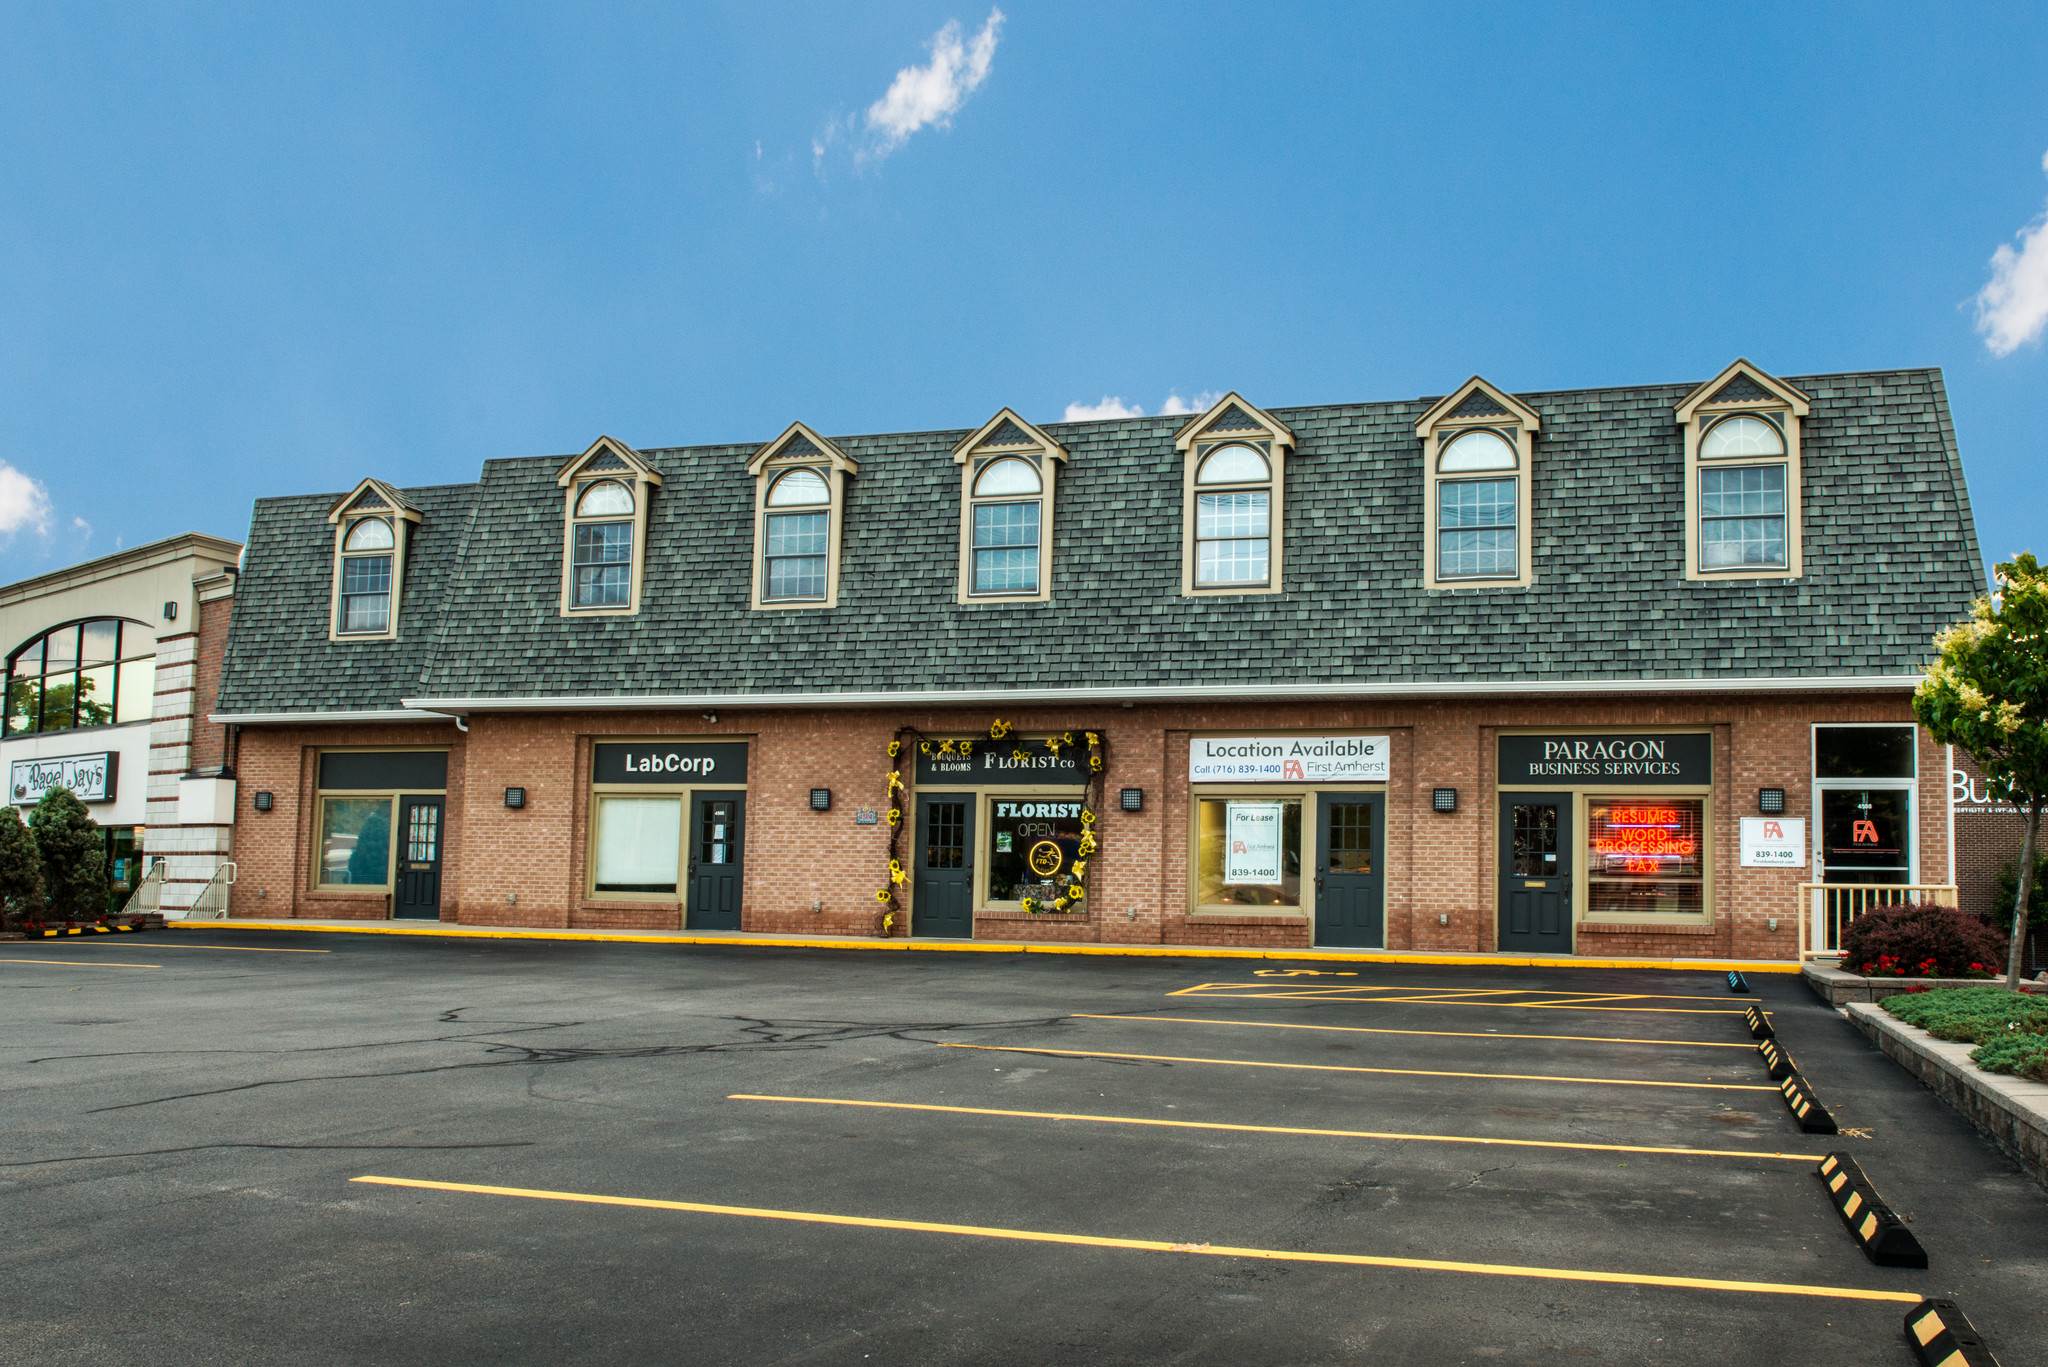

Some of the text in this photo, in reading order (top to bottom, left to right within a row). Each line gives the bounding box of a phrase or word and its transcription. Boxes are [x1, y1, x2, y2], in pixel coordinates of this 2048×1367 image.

[1206, 740, 1375, 757] Location Available
[1544, 740, 1665, 760] PARAGON
[626, 753, 715, 776] LabCorp
[931, 763, 972, 772] & BLOOMS
[1194, 764, 1281, 774] Call (716) 839-1400
[1307, 762, 1332, 772] First
[1334, 761, 1385, 772] Amherst
[1529, 762, 1680, 775] BUSINESS SERVICES
[28, 760, 103, 797] Bagel Jay's
[997, 803, 1081, 818] FLORIST
[1612, 810, 1676, 823] RESUMES
[1235, 814, 1274, 822] For Lease
[1018, 823, 1056, 837] OPEN
[1621, 829, 1667, 841] WORD
[1596, 841, 1692, 854] PROCESSING
[1231, 868, 1275, 876] 839-1400
[1628, 860, 1658, 872] FAX
